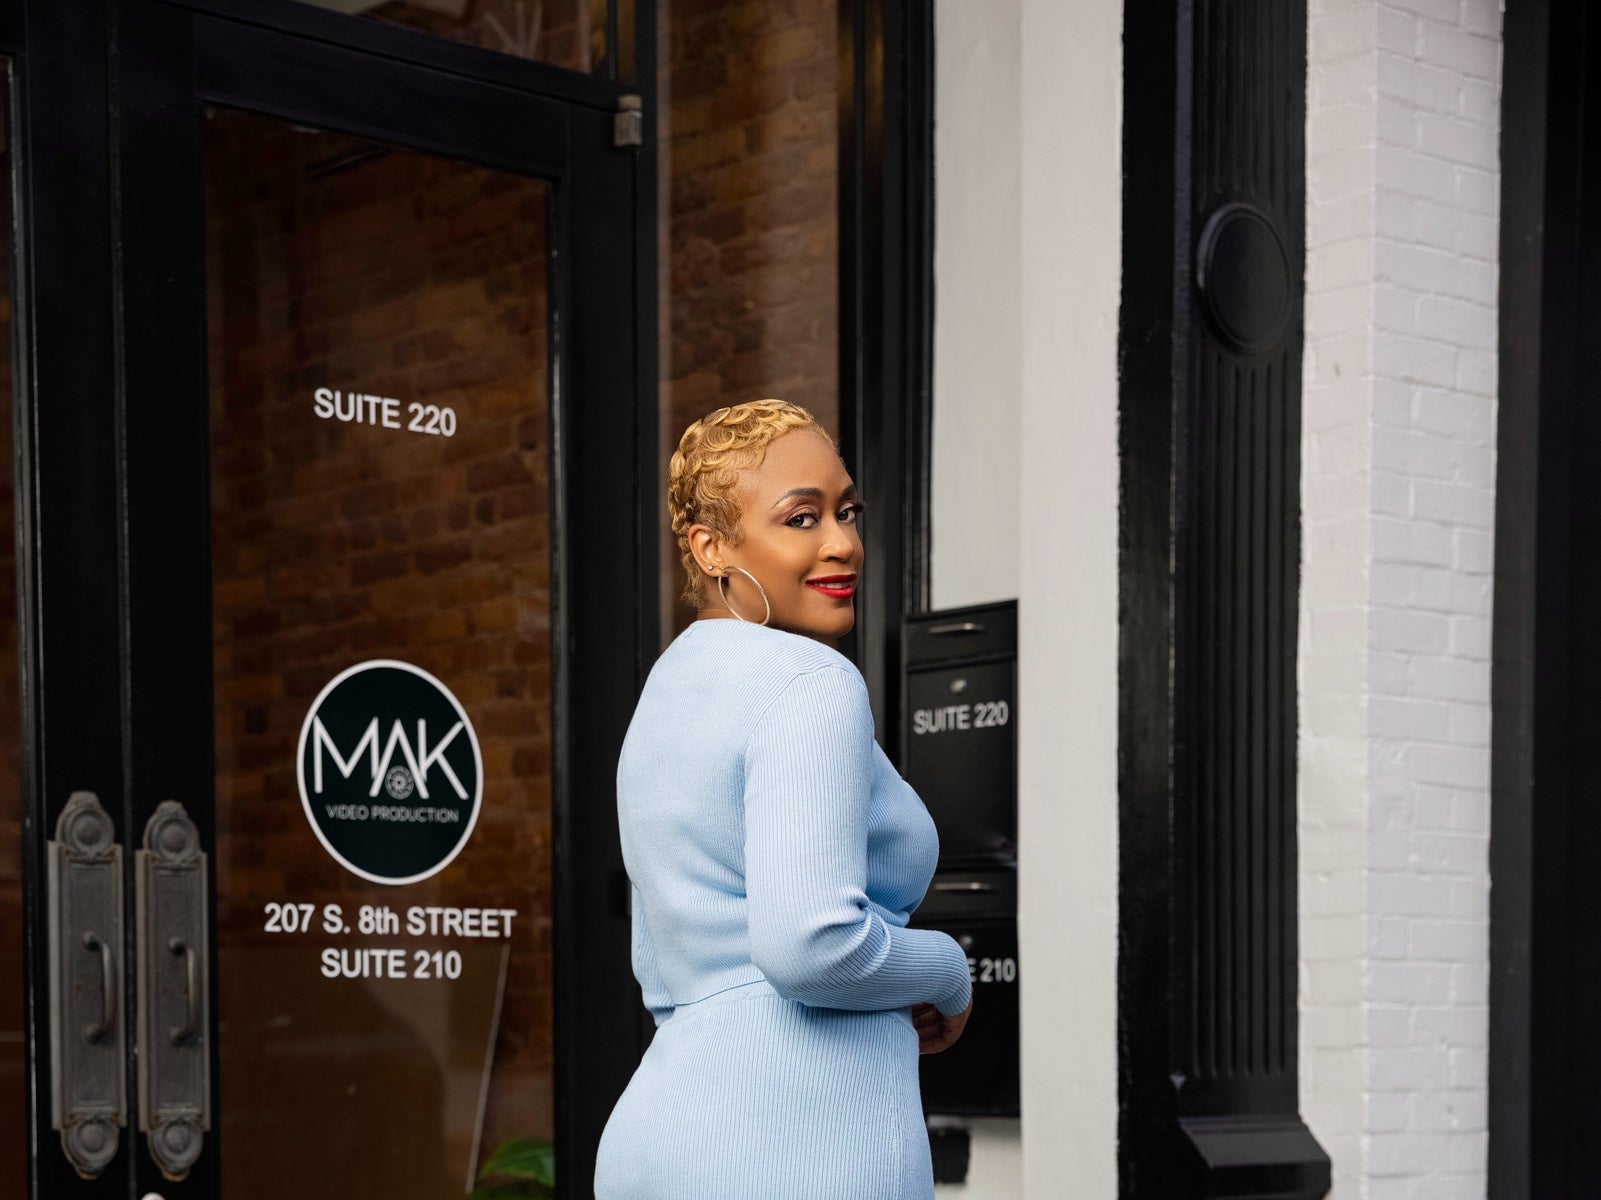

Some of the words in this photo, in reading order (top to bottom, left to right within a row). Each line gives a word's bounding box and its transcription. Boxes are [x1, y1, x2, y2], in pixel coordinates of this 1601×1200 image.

[314, 388, 401, 429] SUITE
[408, 403, 456, 437] 220
[914, 705, 970, 734] SUITE
[974, 701, 1008, 728] 220
[312, 714, 469, 800] MAK
[326, 804, 369, 820] VIDEO
[371, 805, 459, 823] PRODUCTION
[265, 903, 315, 932] 207
[323, 904, 350, 933] S.
[359, 905, 399, 934] 8th
[406, 906, 517, 937] STREET
[321, 948, 407, 978] SUITE
[414, 950, 461, 979] 210
[980, 958, 1015, 982] 210
